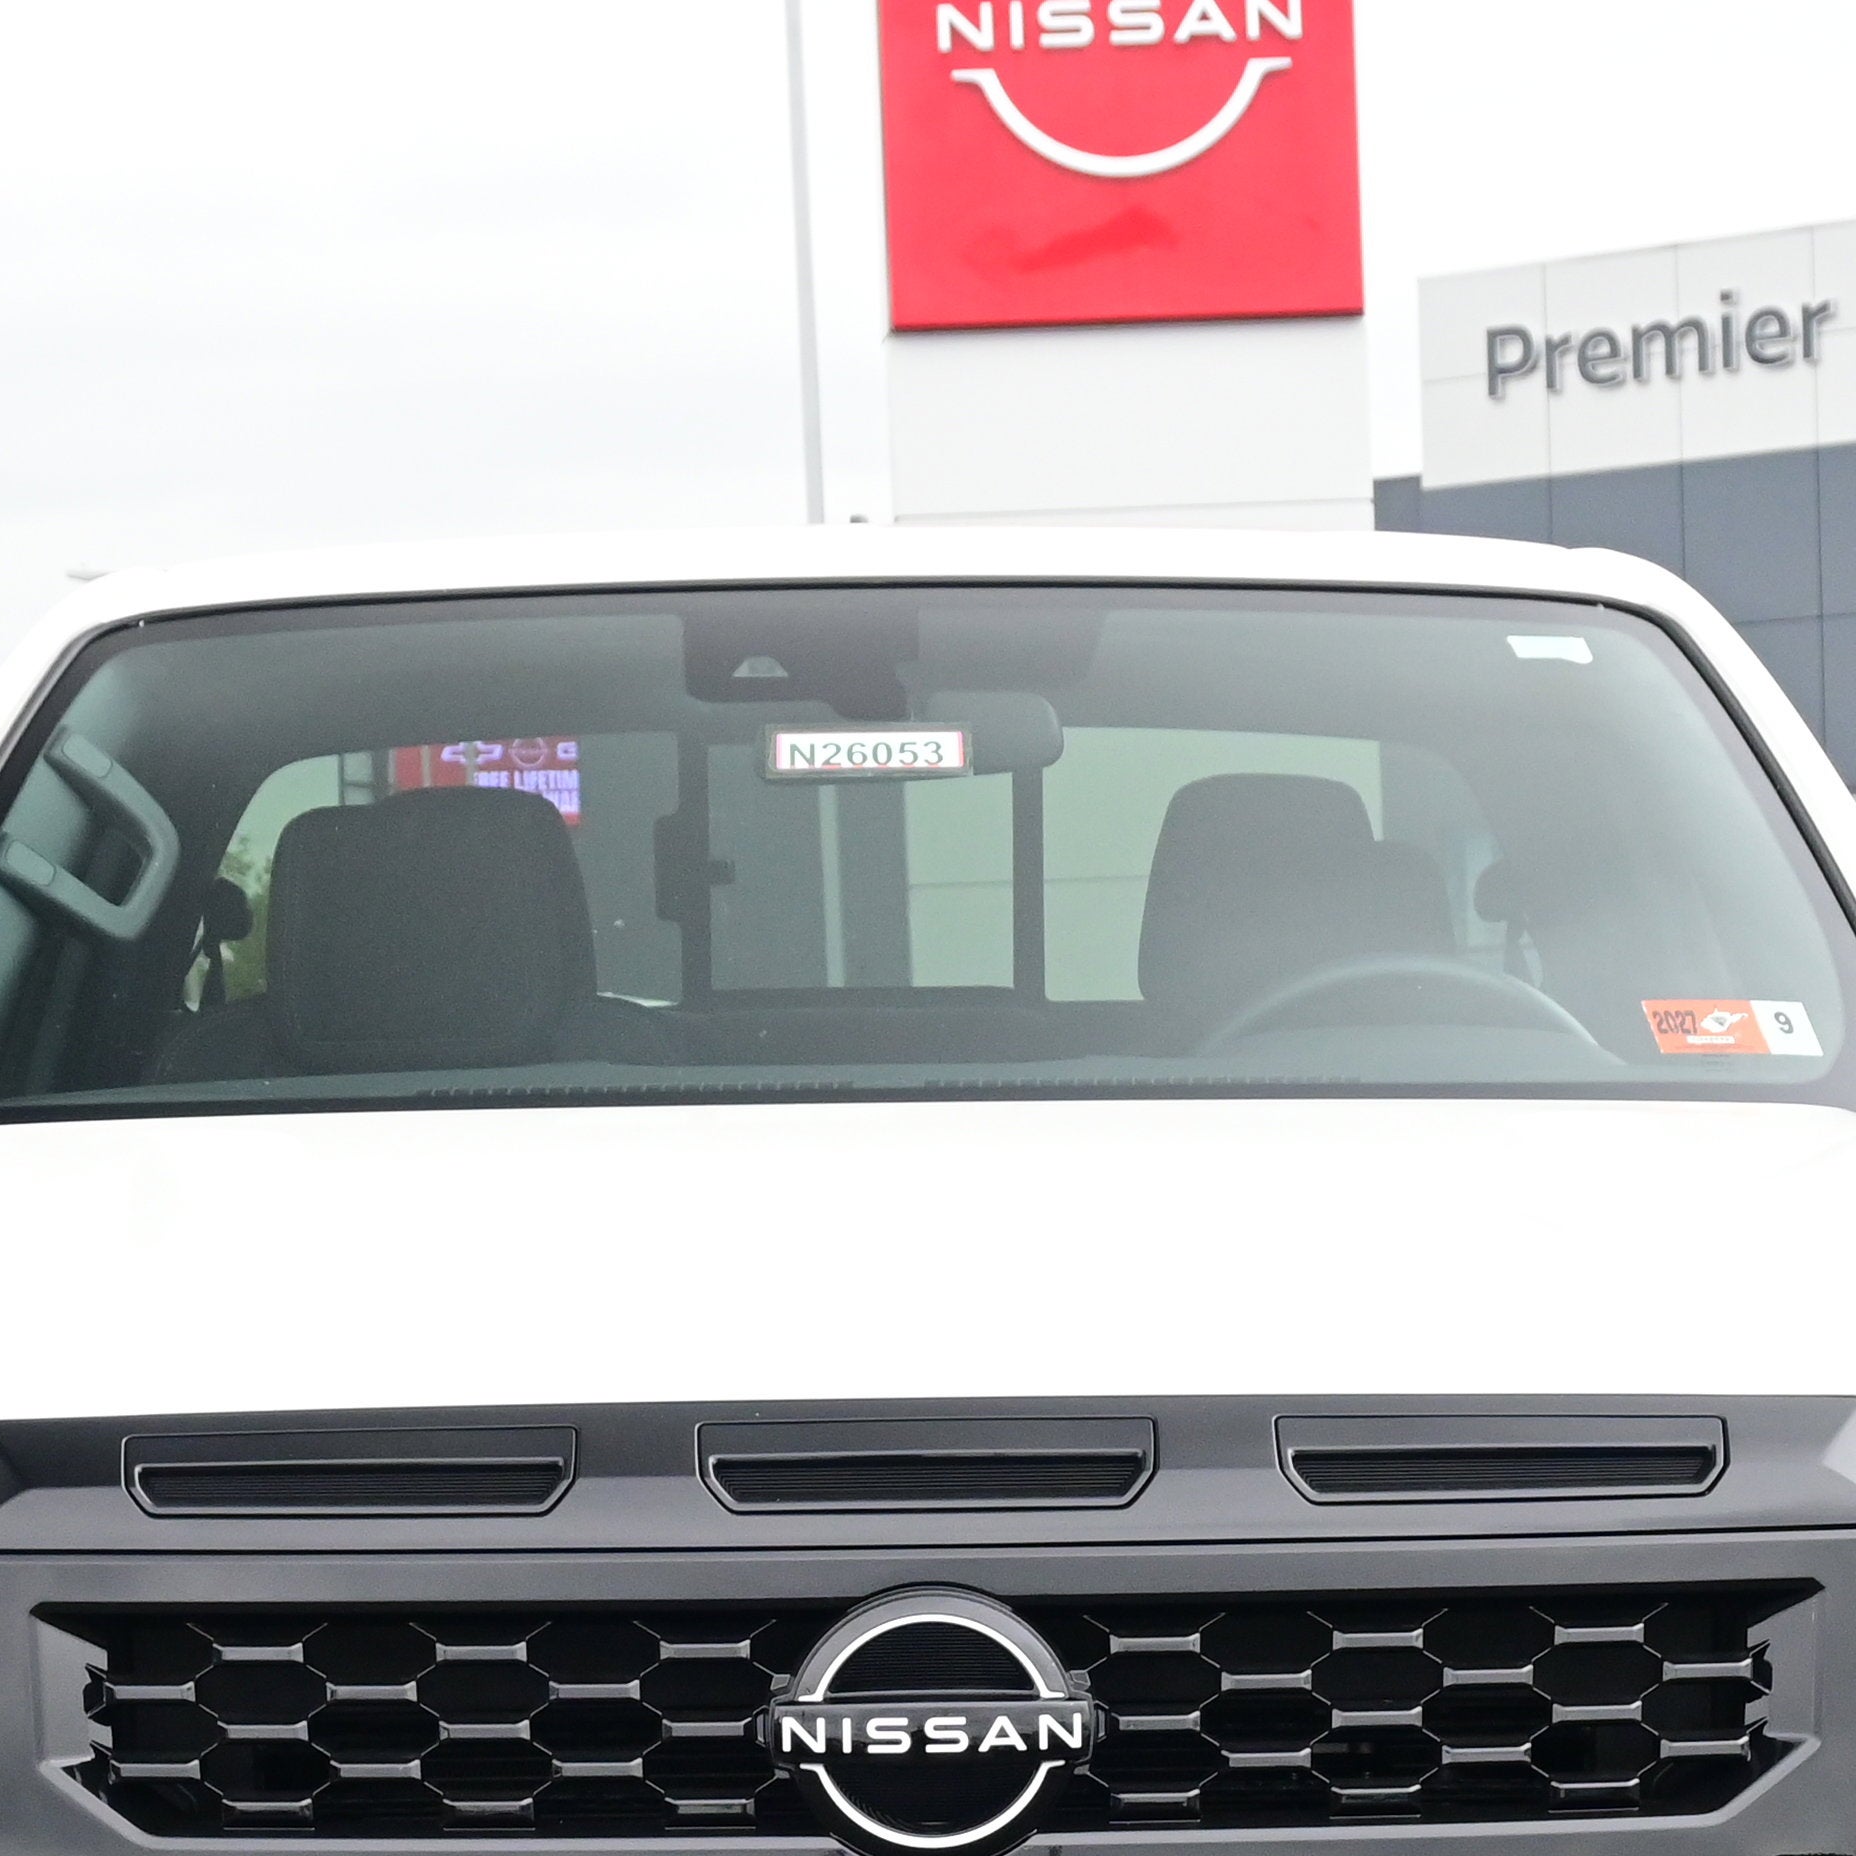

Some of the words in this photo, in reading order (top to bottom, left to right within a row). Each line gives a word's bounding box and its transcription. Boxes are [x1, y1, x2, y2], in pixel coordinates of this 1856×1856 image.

[935, 0, 1305, 54] NISSAN
[1485, 288, 1836, 400] Premier
[789, 740, 944, 767] N26053
[1652, 1009, 1698, 1036] 2027
[1774, 1011, 1795, 1035] 9
[781, 1711, 1083, 1755] NISSAN
